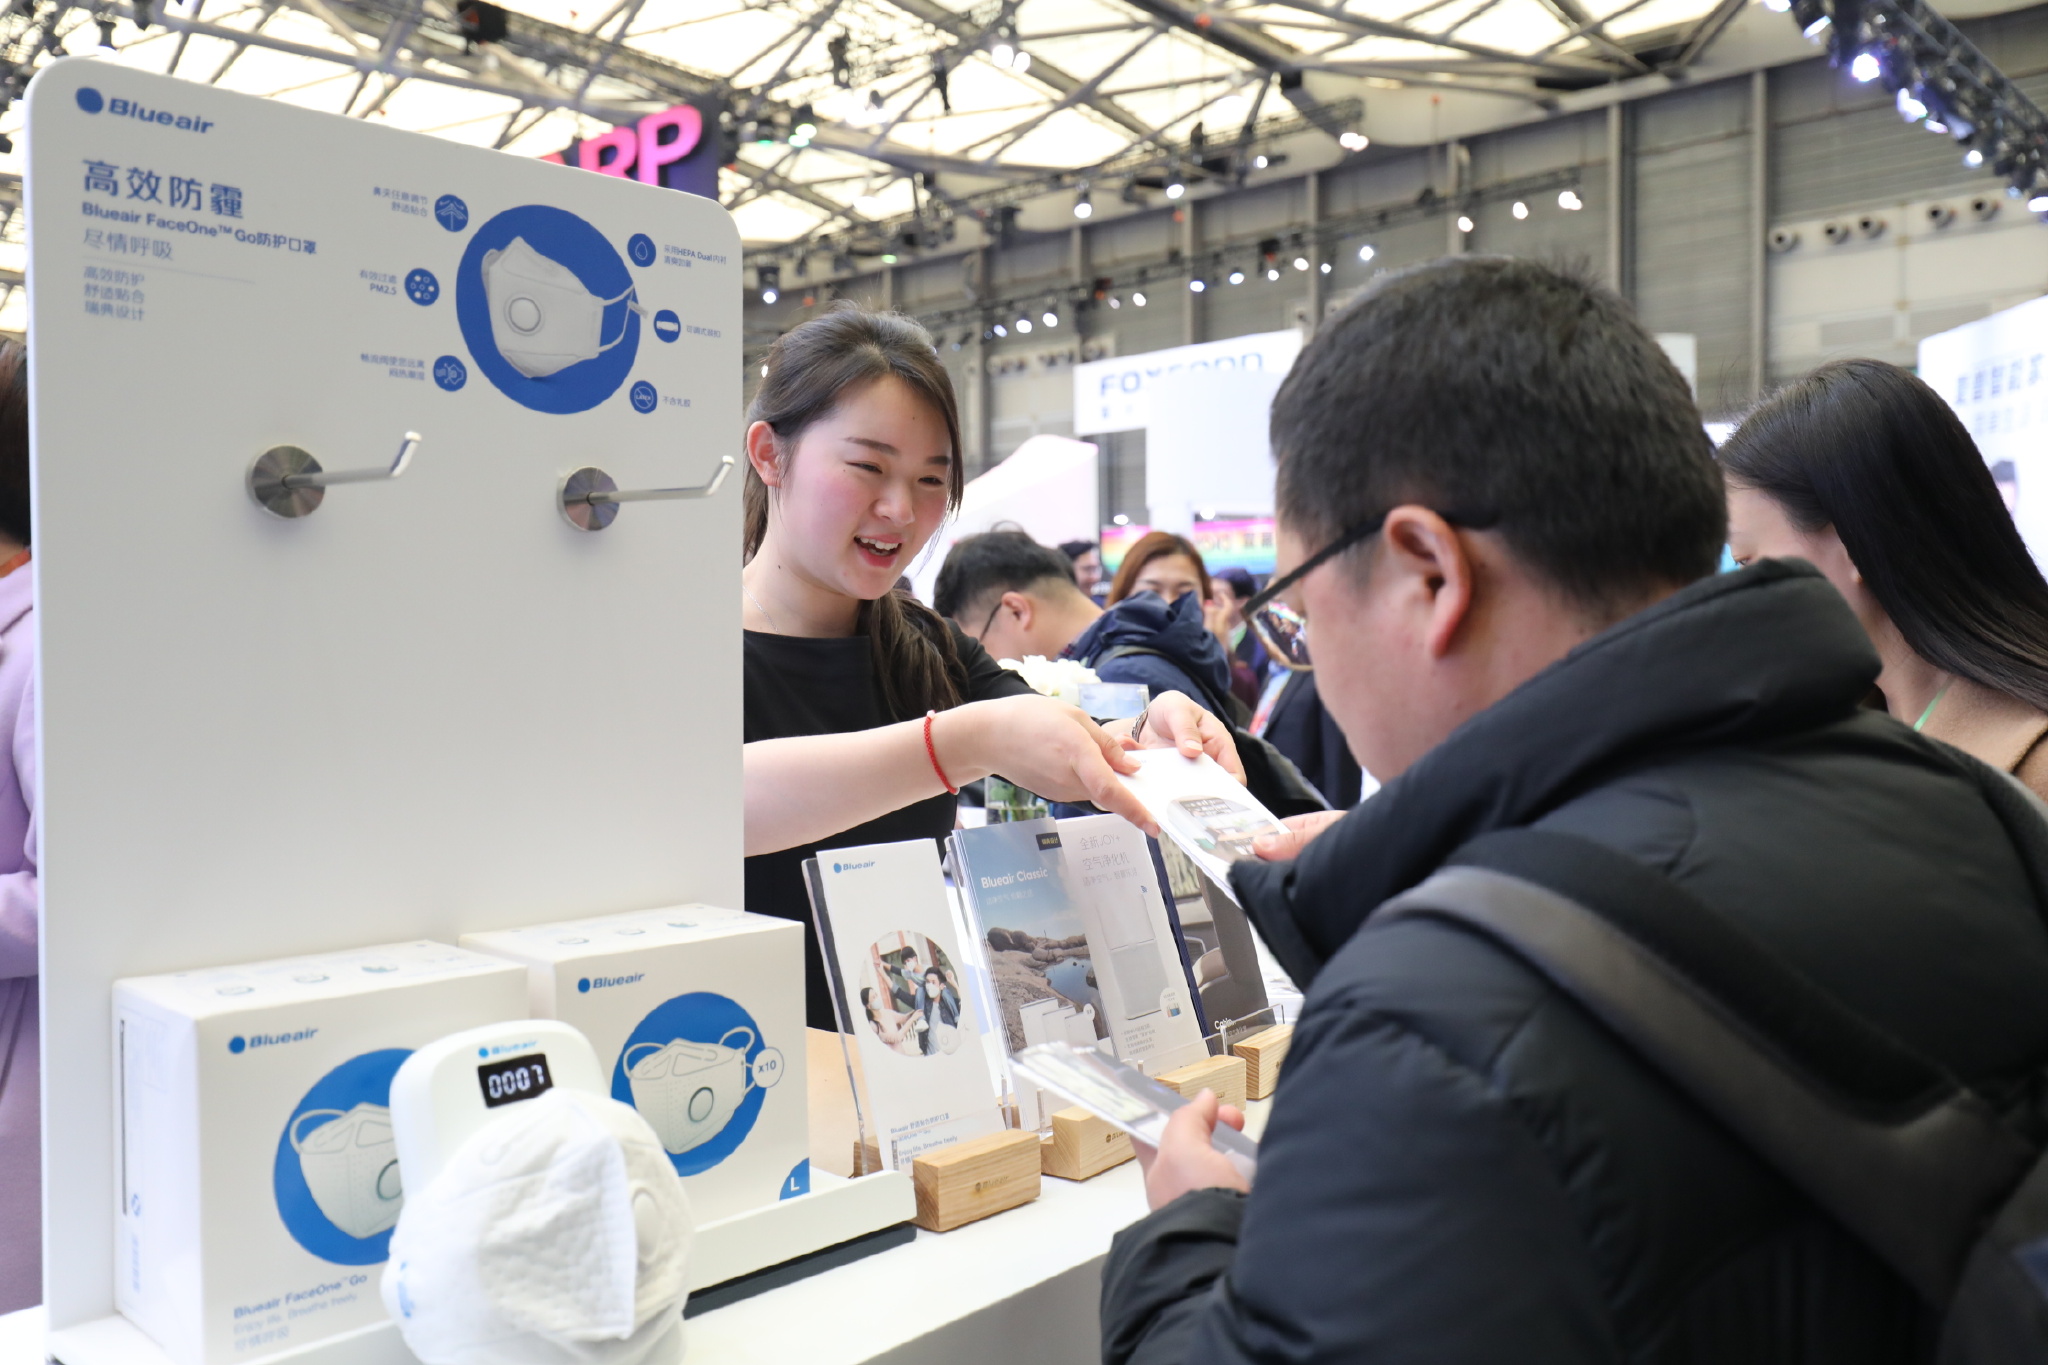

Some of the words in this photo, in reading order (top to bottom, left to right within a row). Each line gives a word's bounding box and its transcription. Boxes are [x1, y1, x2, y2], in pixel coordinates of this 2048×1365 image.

[108, 97, 214, 134] Blueair
[541, 104, 702, 187] RP
[82, 159, 243, 219] 高效防霾
[82, 202, 141, 224] Blueair
[83, 228, 174, 261] 尽情呼吸
[84, 266, 145, 286] 高效防护
[84, 283, 145, 304] 舒适贴合
[370, 283, 397, 295] PM2.5
[84, 301, 144, 321] 瑞典设计
[843, 860, 875, 871] Blueair
[1082, 852, 1129, 870] 空气净化机
[980, 872, 1015, 889] Blueair
[1016, 866, 1048, 882] Classic
[592, 972, 645, 990] Blueair
[249, 1027, 318, 1049] Blueair
[491, 1040, 538, 1055] Blueair
[488, 1064, 545, 1098] 0007
[790, 1177, 799, 1191] L
[233, 1298, 281, 1319] Blueair
